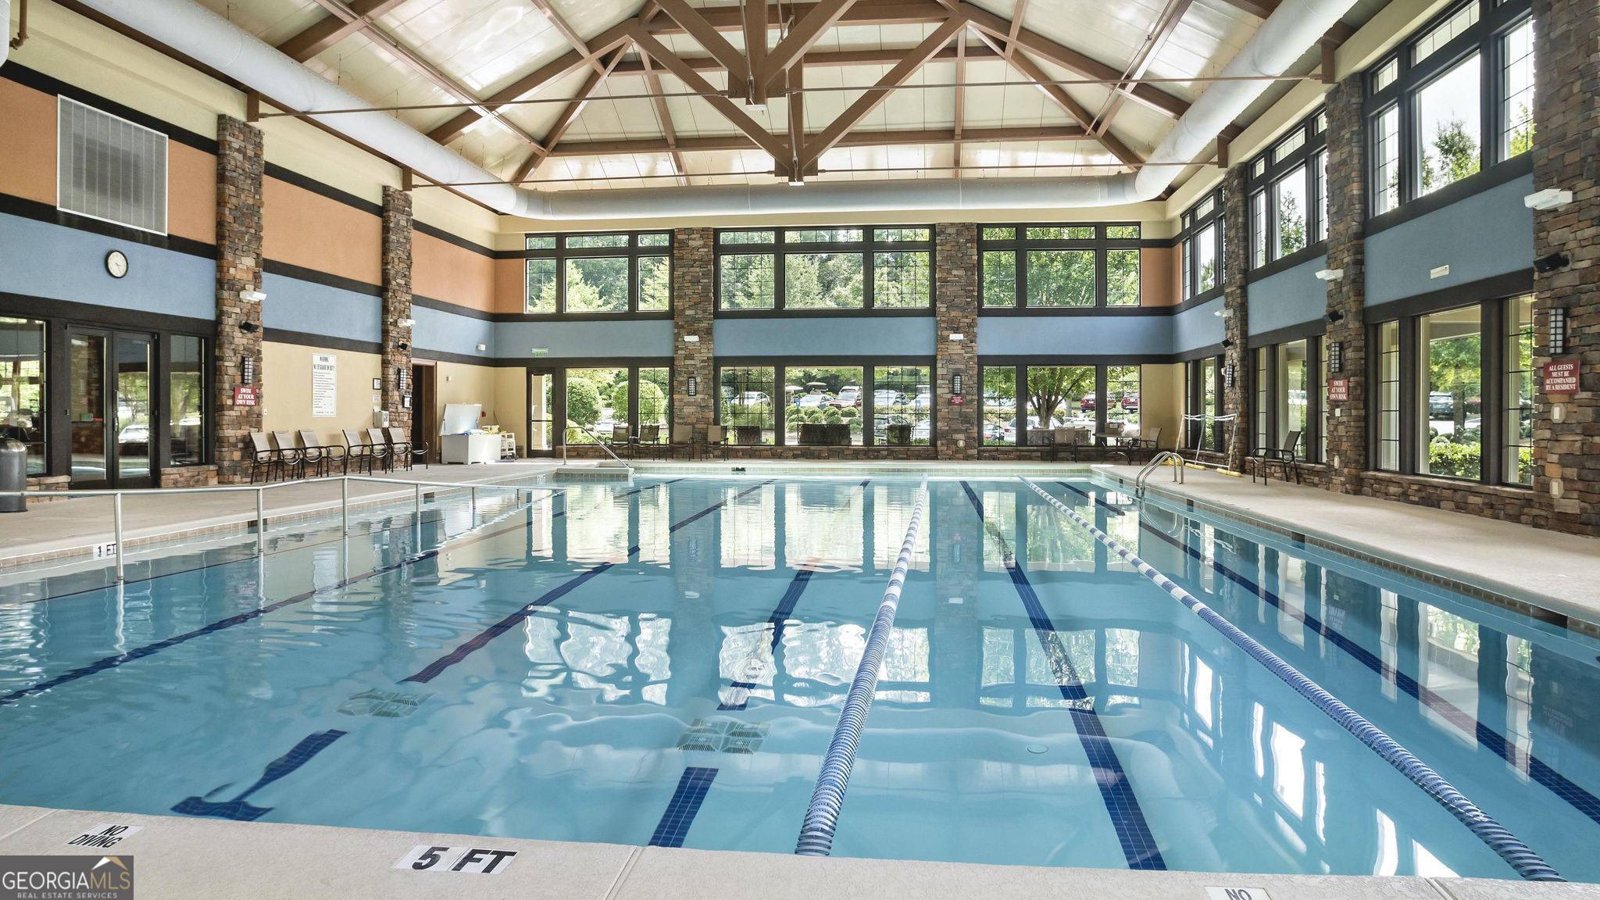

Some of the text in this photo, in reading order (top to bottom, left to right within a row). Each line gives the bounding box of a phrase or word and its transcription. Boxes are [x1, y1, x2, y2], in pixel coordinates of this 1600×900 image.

[98, 825, 129, 836] NO
[67, 834, 123, 848] DIVING
[411, 846, 518, 874] 5 FT
[1224, 888, 1253, 900] NO
